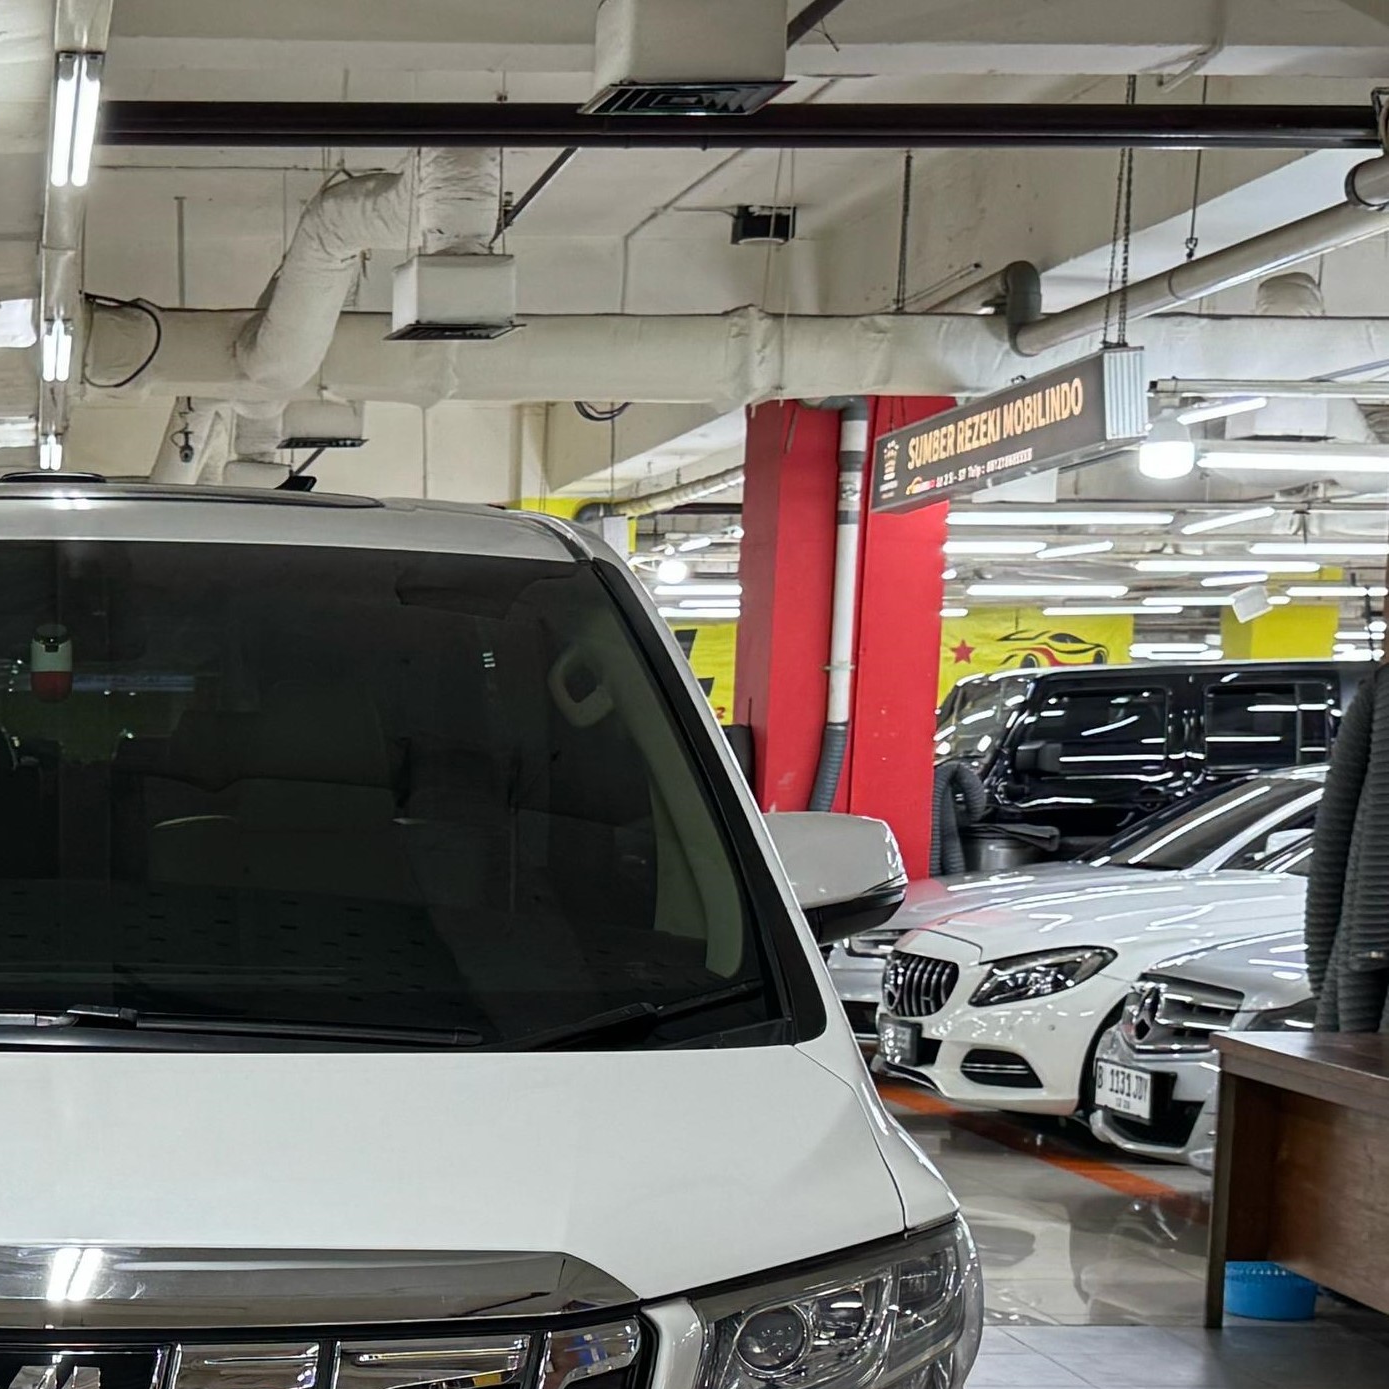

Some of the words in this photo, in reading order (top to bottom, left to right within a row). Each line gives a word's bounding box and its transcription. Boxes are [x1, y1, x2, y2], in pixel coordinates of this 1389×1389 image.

[907, 424, 955, 470] SUMBER
[956, 406, 1000, 454] REZEKI
[1003, 377, 1083, 438] MOBILINDO
